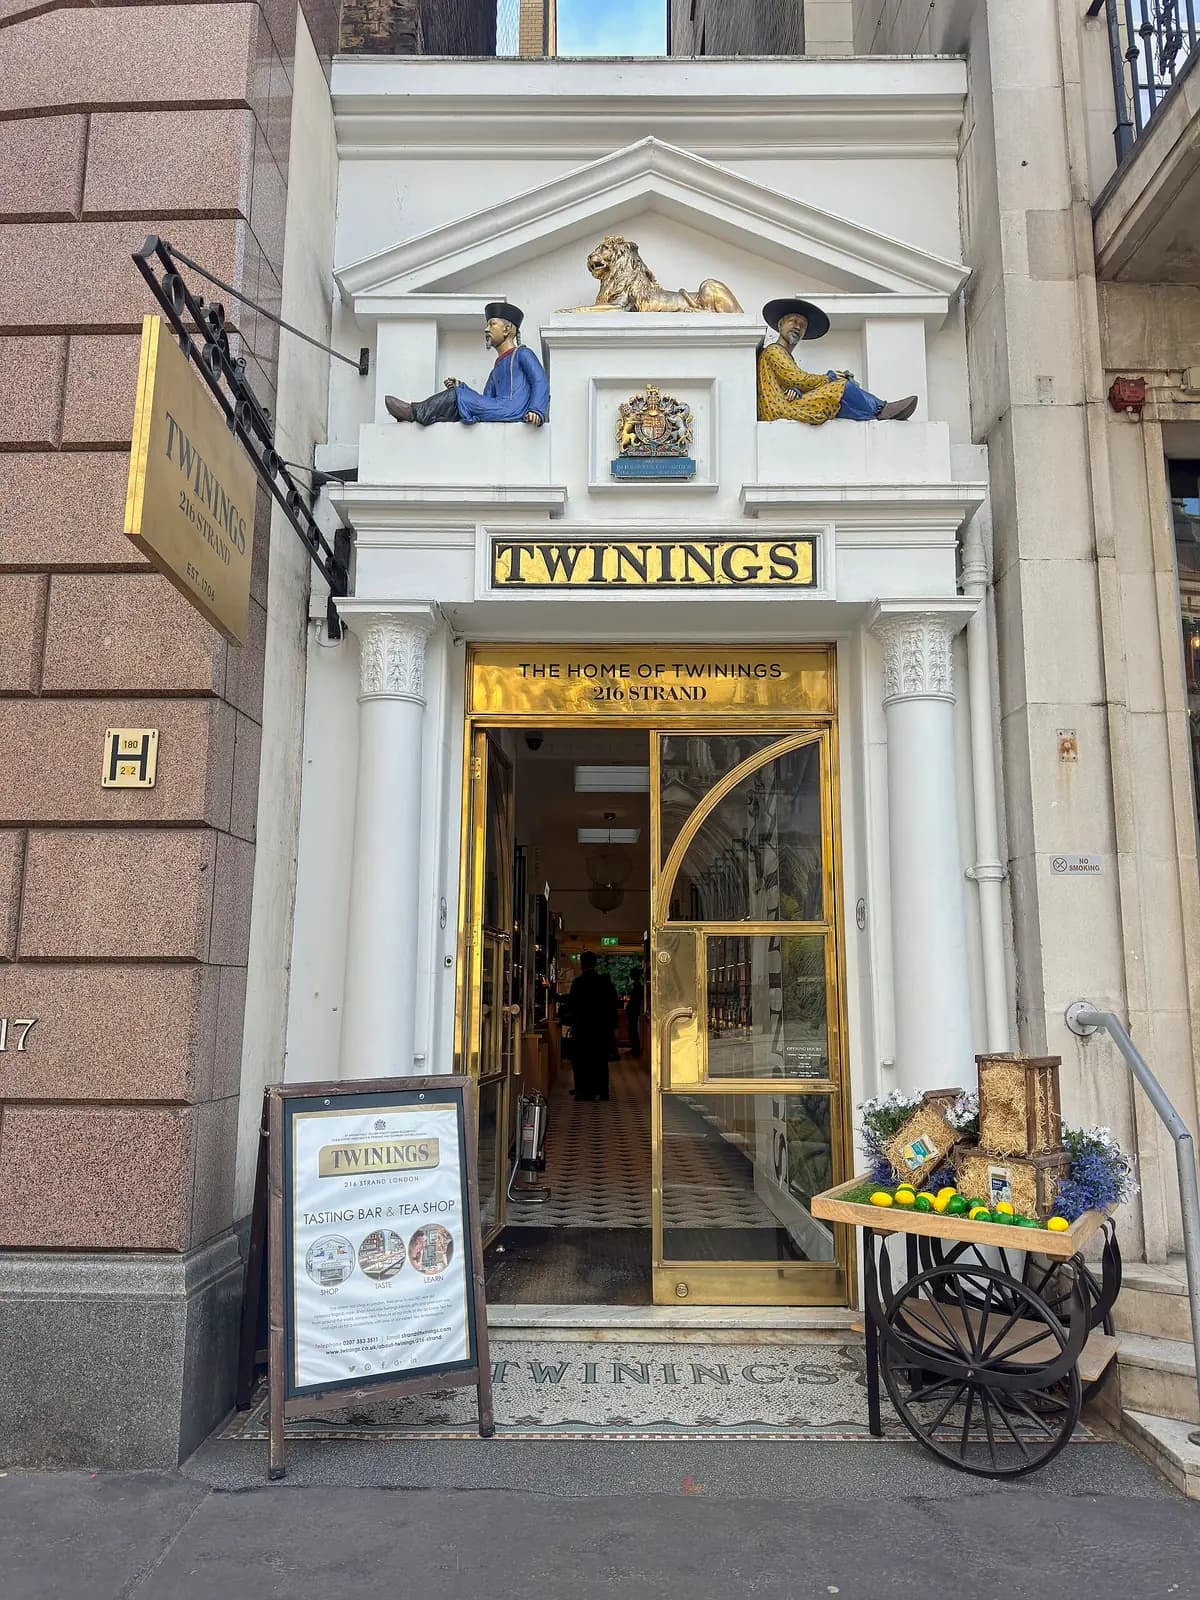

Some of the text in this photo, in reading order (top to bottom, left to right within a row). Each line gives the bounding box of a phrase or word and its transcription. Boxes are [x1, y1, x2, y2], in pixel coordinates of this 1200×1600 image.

[165, 410, 247, 556] TWININGS
[178, 489, 231, 567] 216 STRAND
[497, 542, 799, 582] TWININGS
[200, 574, 215, 602] 1706
[519, 662, 782, 678] THE HOME OF TWININGS
[593, 685, 707, 701] 216 STRAND
[109, 734, 150, 781] H
[1069, 864, 1100, 872] SMOKING
[1079, 857, 1089, 865] NO
[331, 1143, 430, 1169] TWININGS
[344, 1175, 419, 1188] 216 STRAND LONDON
[303, 1199, 456, 1225] TASTING BAR & TEA SHOP
[375, 1281, 393, 1290] TASTE
[423, 1276, 444, 1284] LEARN
[320, 1287, 339, 1297] SHOP
[489, 1361, 839, 1386] TWININGS
